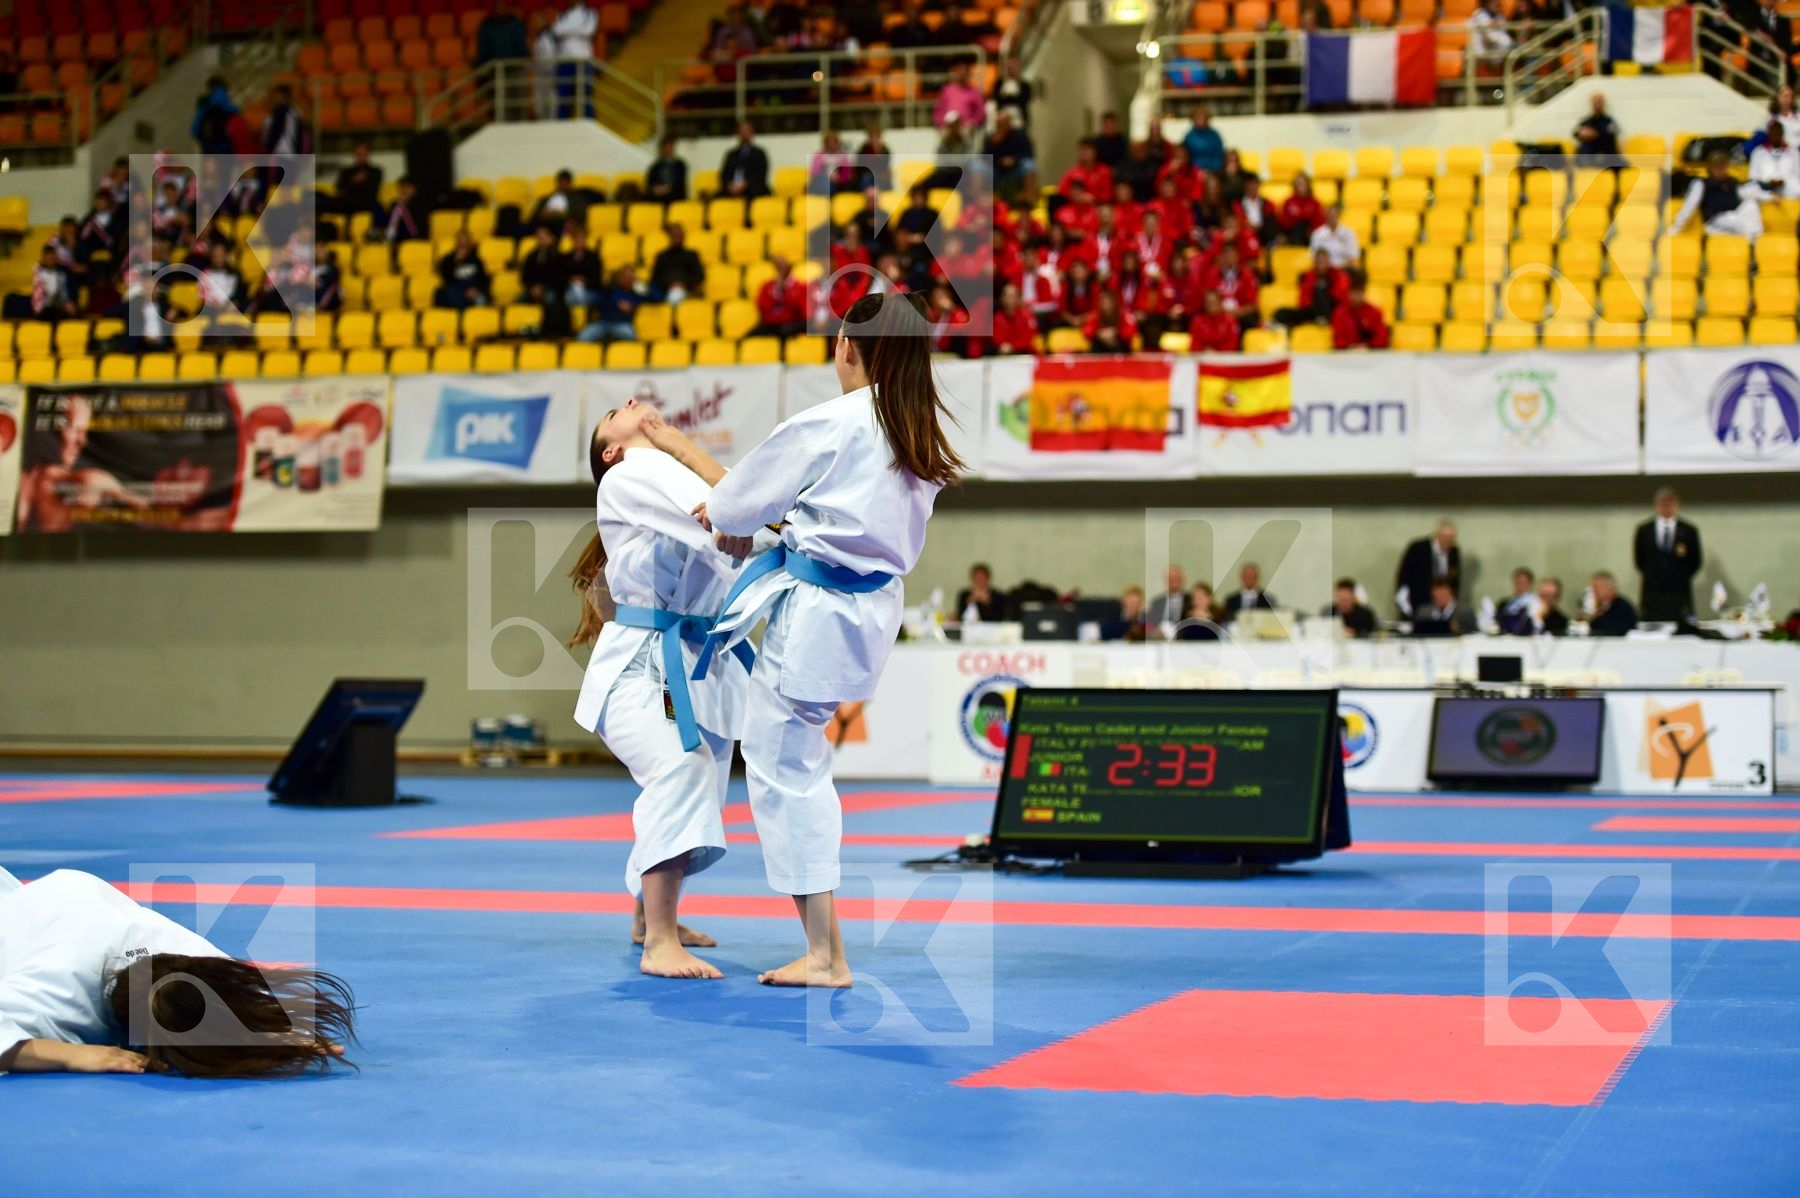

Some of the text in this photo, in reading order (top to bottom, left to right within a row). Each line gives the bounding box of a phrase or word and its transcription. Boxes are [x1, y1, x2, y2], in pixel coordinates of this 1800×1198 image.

[957, 650, 1047, 676] COACH
[1055, 722, 1092, 734] Team
[1095, 723, 1136, 735] Cadet
[1138, 724, 1166, 735] and
[1168, 724, 1215, 736] Junior
[1217, 723, 1270, 737] Female
[1107, 742, 1218, 787] 2:33
[1748, 761, 1767, 786] 3
[1021, 797, 1082, 809] FEMALE
[1056, 811, 1102, 823] SPAIN
